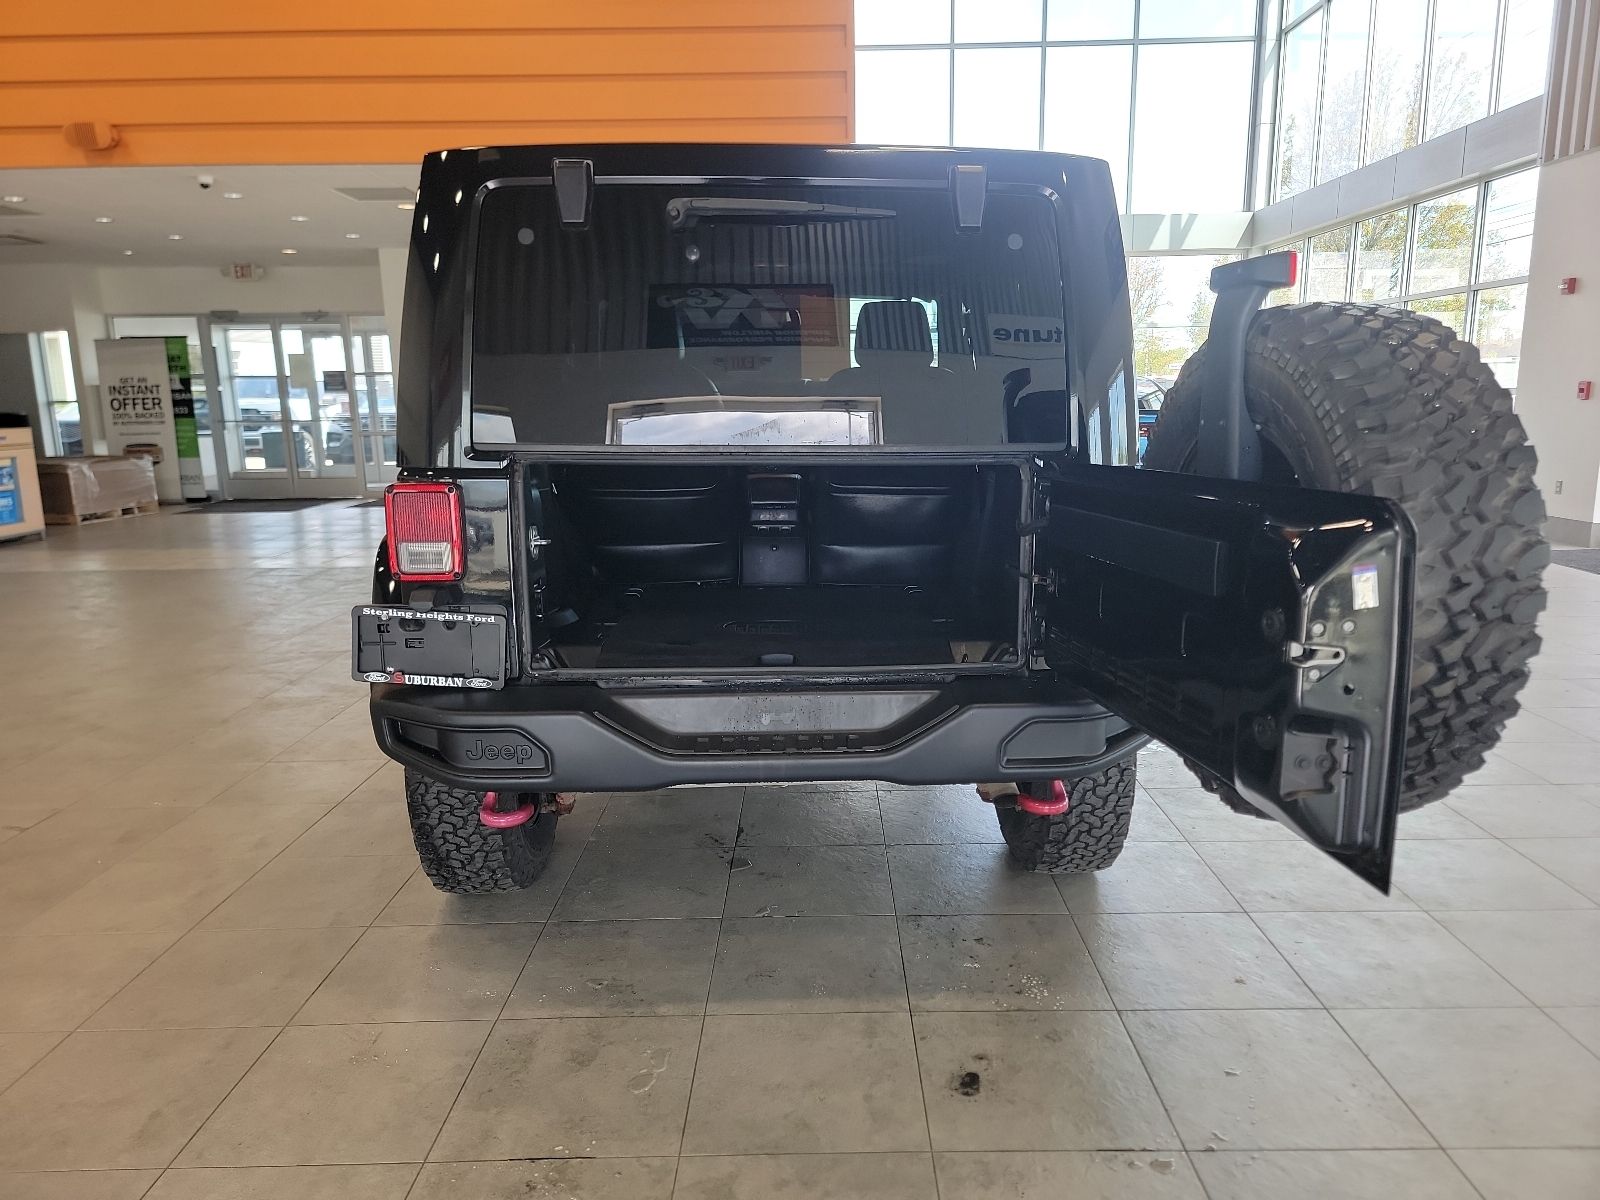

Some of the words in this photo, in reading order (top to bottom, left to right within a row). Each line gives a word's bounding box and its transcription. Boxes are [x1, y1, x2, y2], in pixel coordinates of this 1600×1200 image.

[108, 385, 161, 396] INSTANT
[110, 397, 163, 411] OFFER
[362, 607, 413, 619] Sterling
[465, 614, 496, 623] Ford
[367, 672, 387, 682] Ford
[393, 671, 464, 687] SUBURBAN
[469, 678, 489, 688] Ford
[465, 739, 533, 765] Jeep
